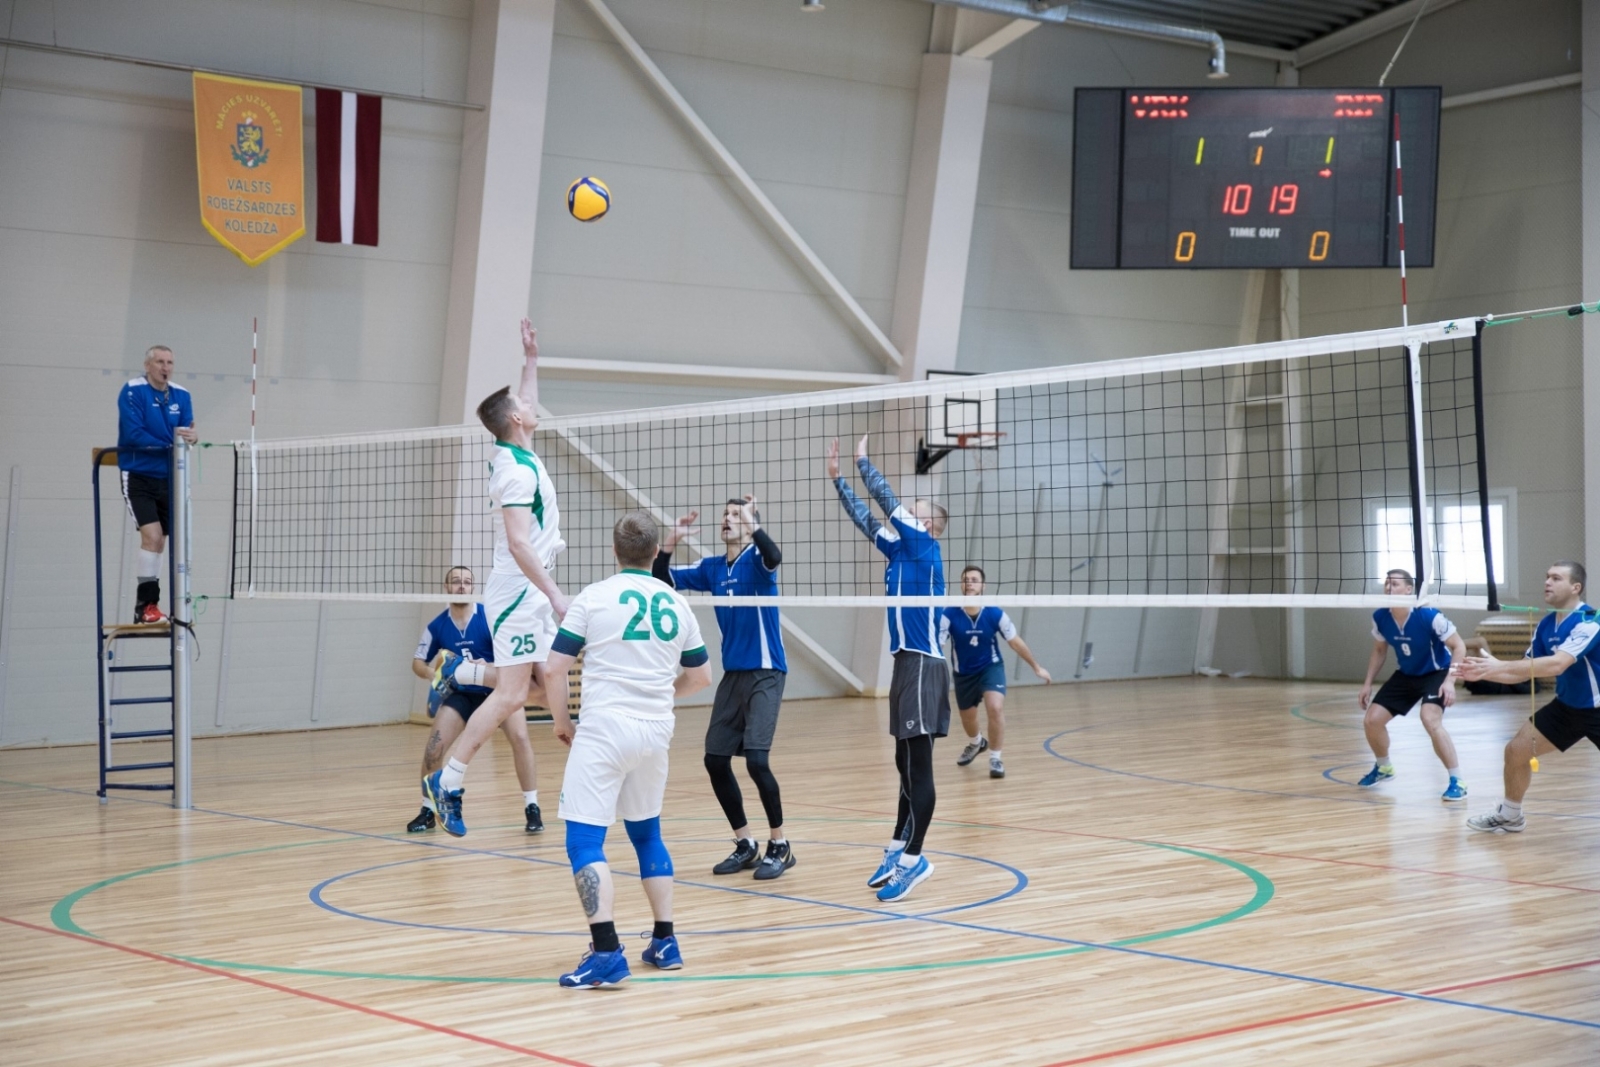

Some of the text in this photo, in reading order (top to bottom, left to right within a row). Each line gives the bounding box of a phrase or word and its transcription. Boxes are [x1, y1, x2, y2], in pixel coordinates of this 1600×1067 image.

[1195, 137, 1205, 165] 1
[1254, 145, 1263, 165] 1
[1325, 137, 1334, 164] 1
[227, 178, 272, 194] VALSTS
[1222, 184, 1299, 215] 10 19
[1229, 227, 1281, 238] TIME OUT
[1308, 231, 1330, 261] 0
[1174, 231, 1197, 262] 0
[618, 589, 679, 642] 26
[510, 633, 537, 656] 25
